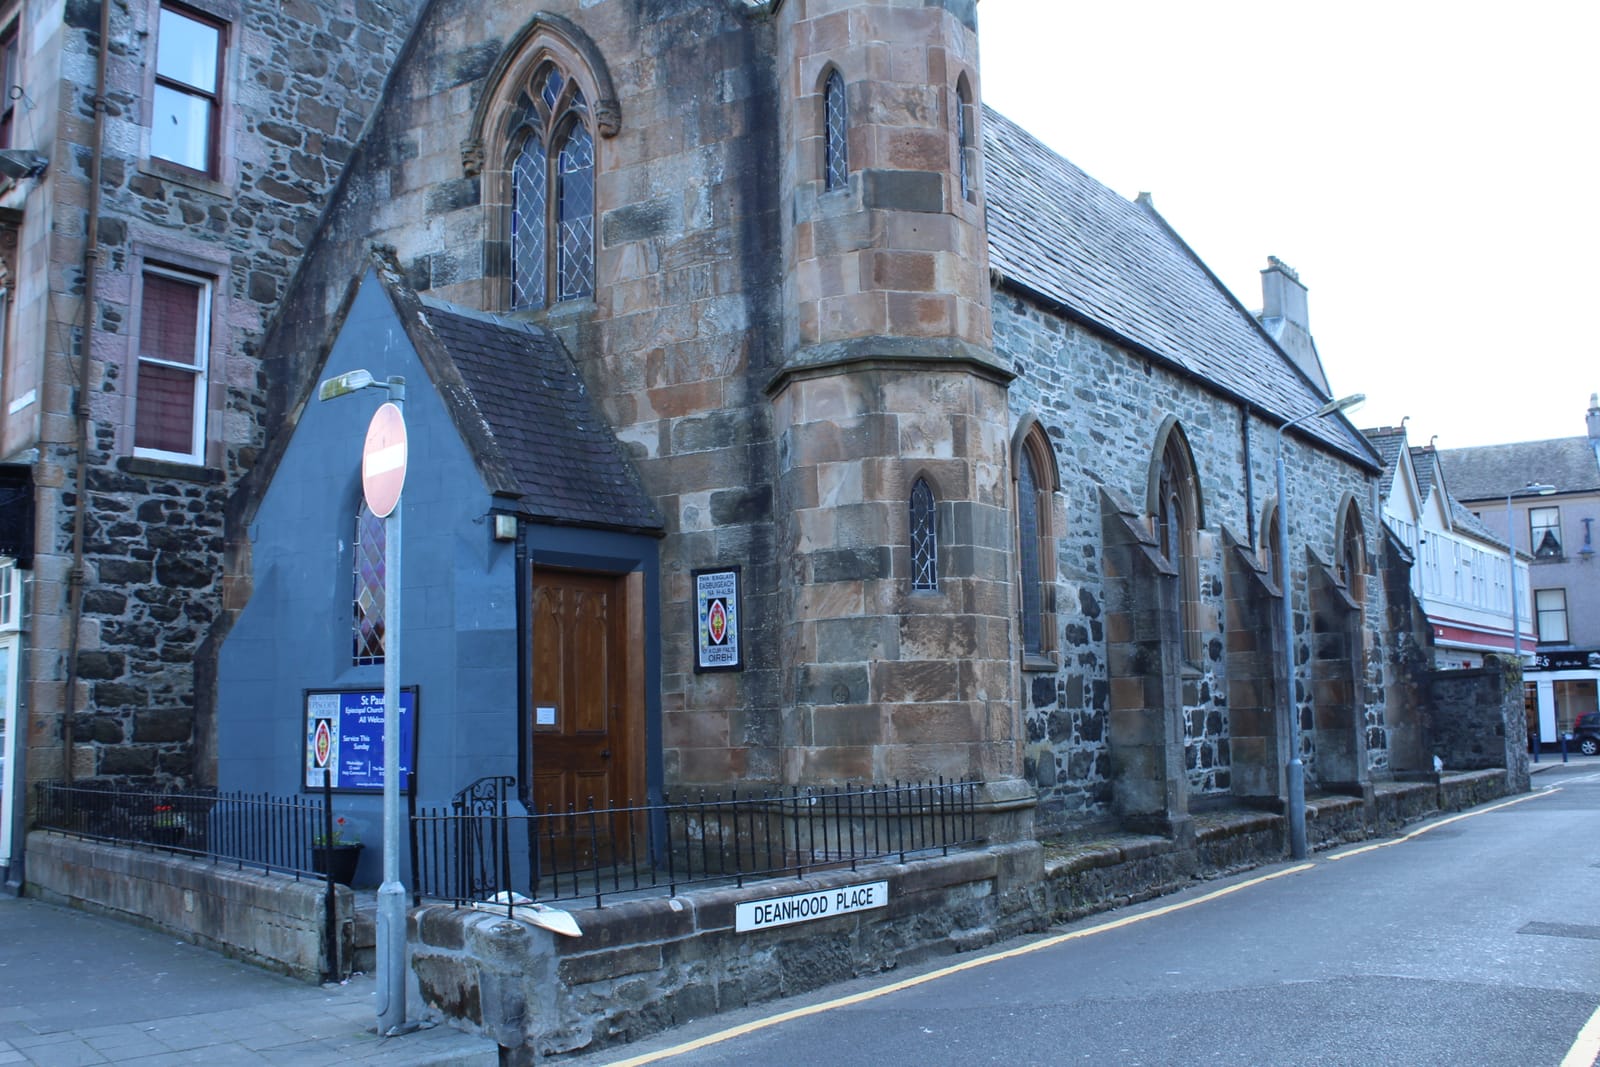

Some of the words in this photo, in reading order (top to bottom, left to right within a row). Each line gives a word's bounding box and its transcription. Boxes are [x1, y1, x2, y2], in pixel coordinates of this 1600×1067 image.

[708, 653, 733, 662] OIRBH
[361, 696, 369, 706] St
[345, 706, 366, 714] Episcopal
[754, 895, 828, 925] DEANHOOD
[836, 887, 873, 910] PLACE
